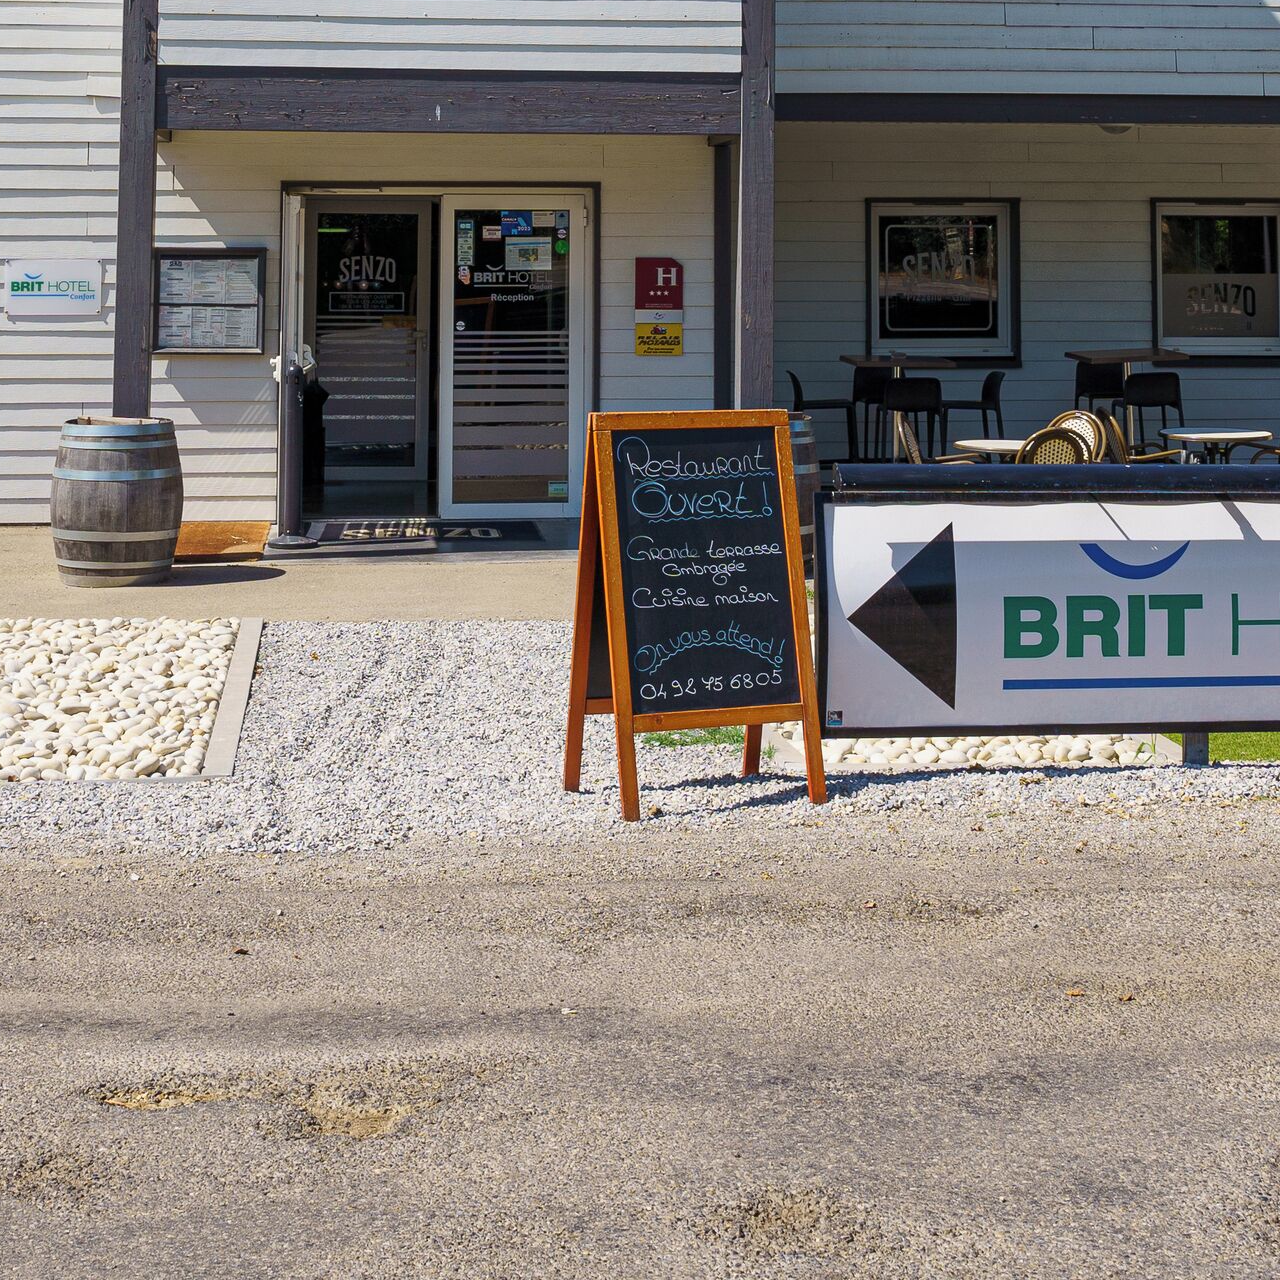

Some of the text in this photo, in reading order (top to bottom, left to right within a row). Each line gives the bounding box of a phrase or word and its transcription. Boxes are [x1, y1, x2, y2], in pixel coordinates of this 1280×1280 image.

[339, 255, 396, 283] SENZO
[474, 272, 505, 283] BRIT
[508, 271, 552, 283] HOTEL
[656, 267, 678, 286] H
[11, 280, 95, 292] BRIT HOTEL
[491, 293, 534, 302] Réception
[632, 585, 779, 609] Cuisine maison
[1003, 594, 1204, 659] BRIT
[634, 643, 670, 672] On
[669, 629, 711, 649] vous
[716, 620, 773, 654] attend
[640, 683, 667, 700] 04
[671, 677, 697, 697] 92
[701, 676, 723, 691] 75
